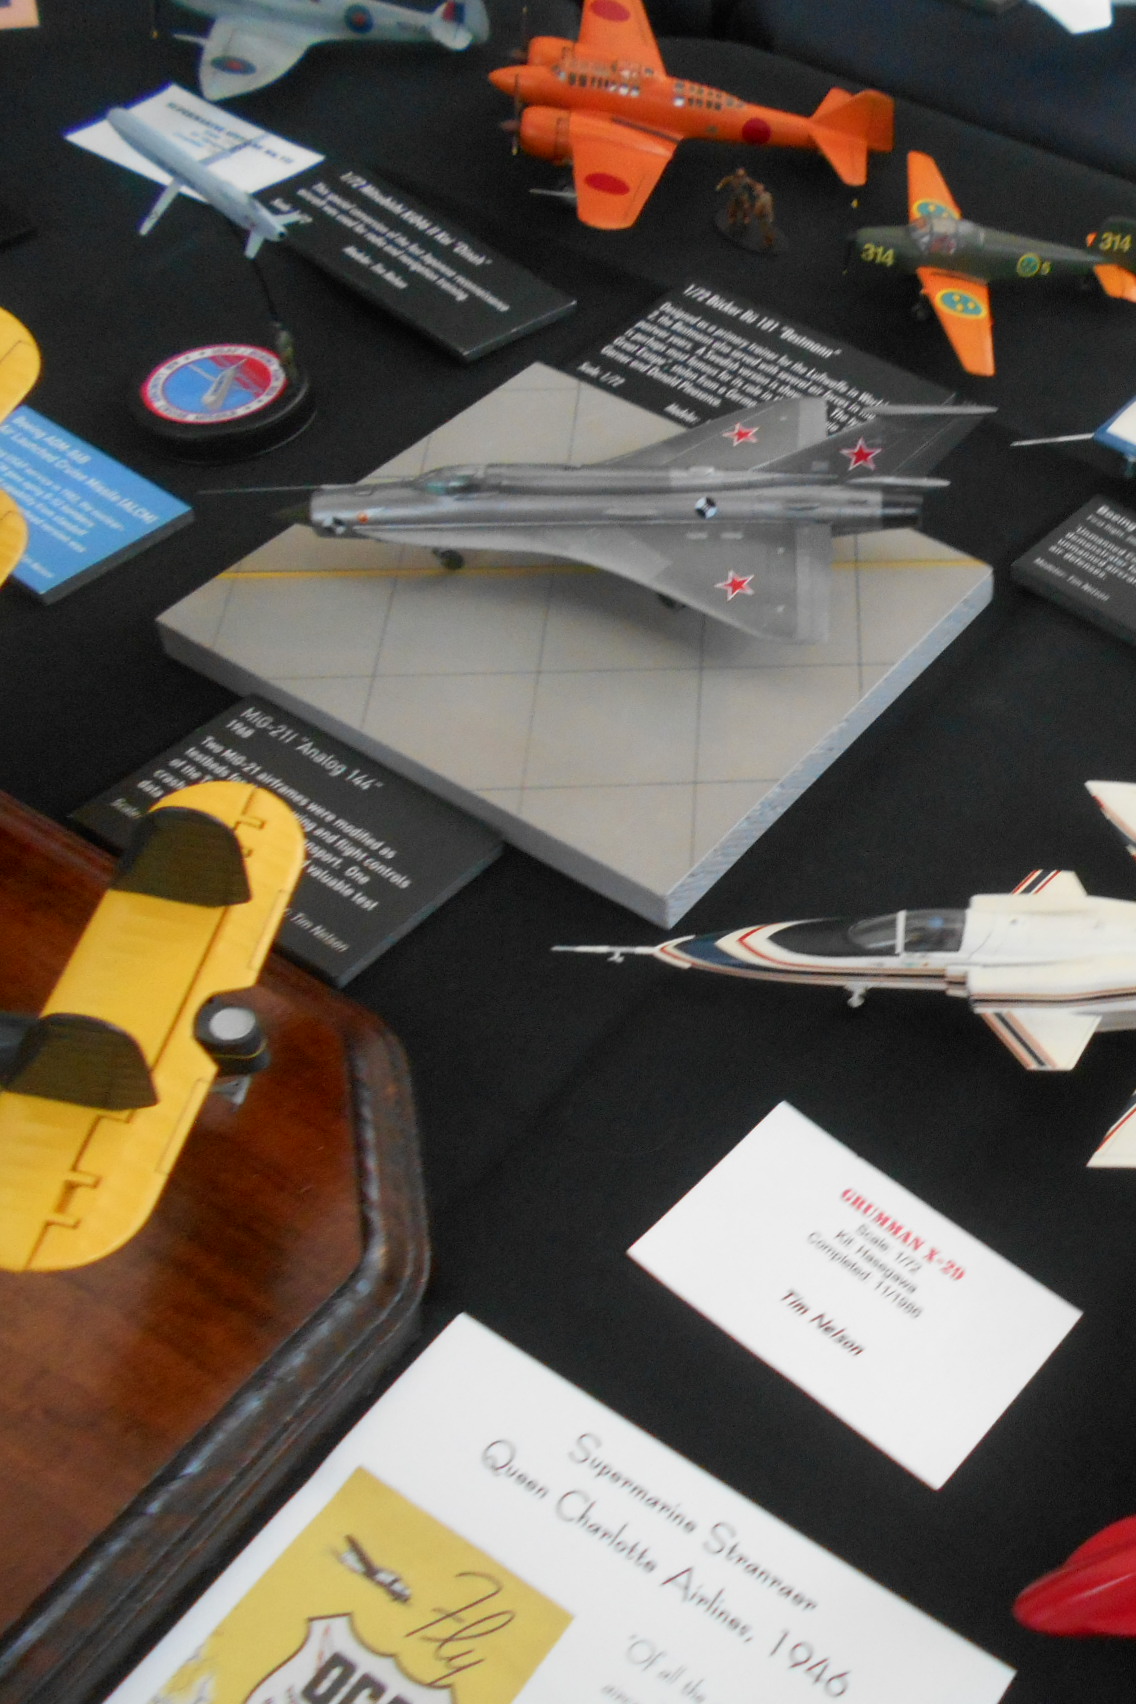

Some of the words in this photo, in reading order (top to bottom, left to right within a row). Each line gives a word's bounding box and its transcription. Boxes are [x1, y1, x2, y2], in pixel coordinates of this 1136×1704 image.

[861, 243, 895, 268] 314
[1099, 231, 1132, 252] 314
[683, 284, 711, 301] 1/72
[11, 415, 45, 438] Boeing
[11, 433, 57, 462] Launched
[86, 478, 120, 501] Missile
[1096, 505, 1136, 531] Boeing
[226, 719, 254, 737] 1968
[296, 737, 346, 776] "Analog
[345, 769, 382, 789] 144"
[137, 780, 163, 797] data
[201, 735, 223, 753] Two
[221, 749, 260, 774] MiG-21
[256, 772, 308, 805] airframes
[306, 802, 335, 821] were
[333, 819, 383, 849] modified
[378, 847, 395, 858] as
[169, 758, 186, 768] of
[180, 765, 201, 779] the
[344, 866, 369, 884] One
[185, 747, 229, 777] testbeds
[313, 828, 338, 843] and
[334, 839, 367, 860] flight
[363, 858, 409, 887] controls
[307, 865, 353, 896] valuable
[351, 892, 378, 910] test
[290, 912, 312, 929] Tim
[309, 925, 348, 951] Nelson
[842, 1189, 923, 1250] GRUMMAN
[924, 1248, 964, 1280] X-29
[856, 1245, 916, 1293] Hasegawa
[895, 1251, 921, 1272] 1/72
[781, 1290, 808, 1314] Tim
[810, 1313, 863, 1355] Nelson
[570, 1433, 695, 1532] Supermarine
[704, 1522, 816, 1609] Stranraer
[482, 1439, 548, 1498] Queen
[556, 1490, 656, 1572] Charlotte
[661, 1567, 751, 1642] Airlines,
[770, 1632, 848, 1697] 1946
[404, 1571, 515, 1686] Fly
[657, 1664, 688, 1685] all
